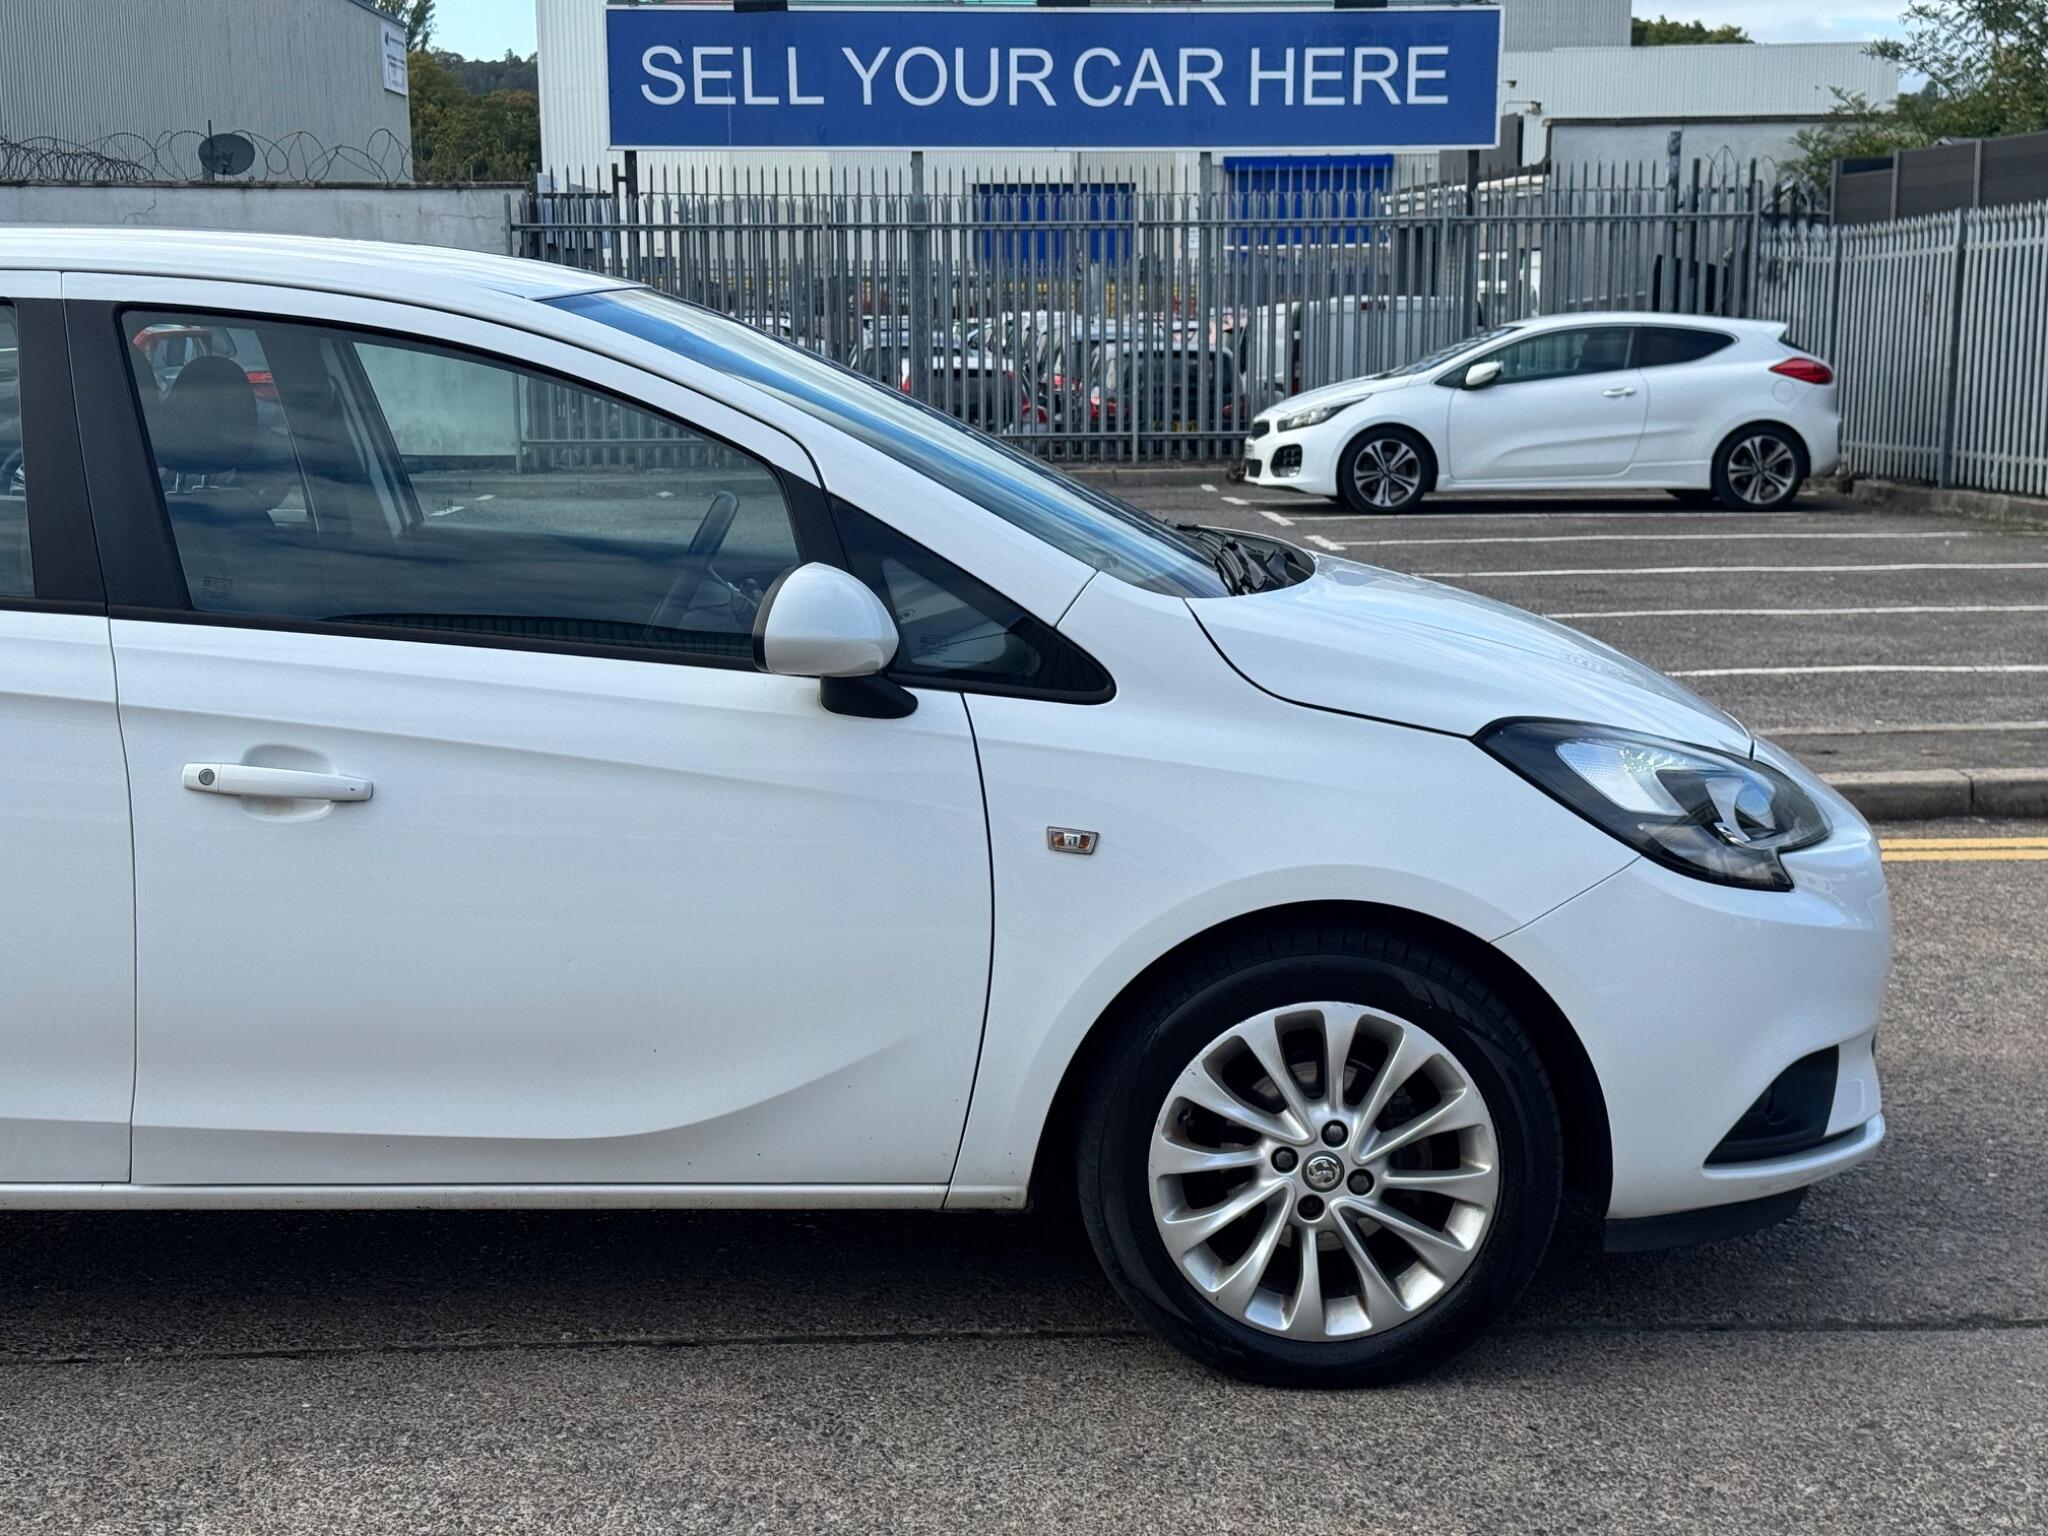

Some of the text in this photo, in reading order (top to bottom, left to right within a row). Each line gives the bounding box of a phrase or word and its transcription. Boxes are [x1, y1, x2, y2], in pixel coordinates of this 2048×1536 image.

[641, 46, 1448, 106] SELL YOUR CAR HERE
